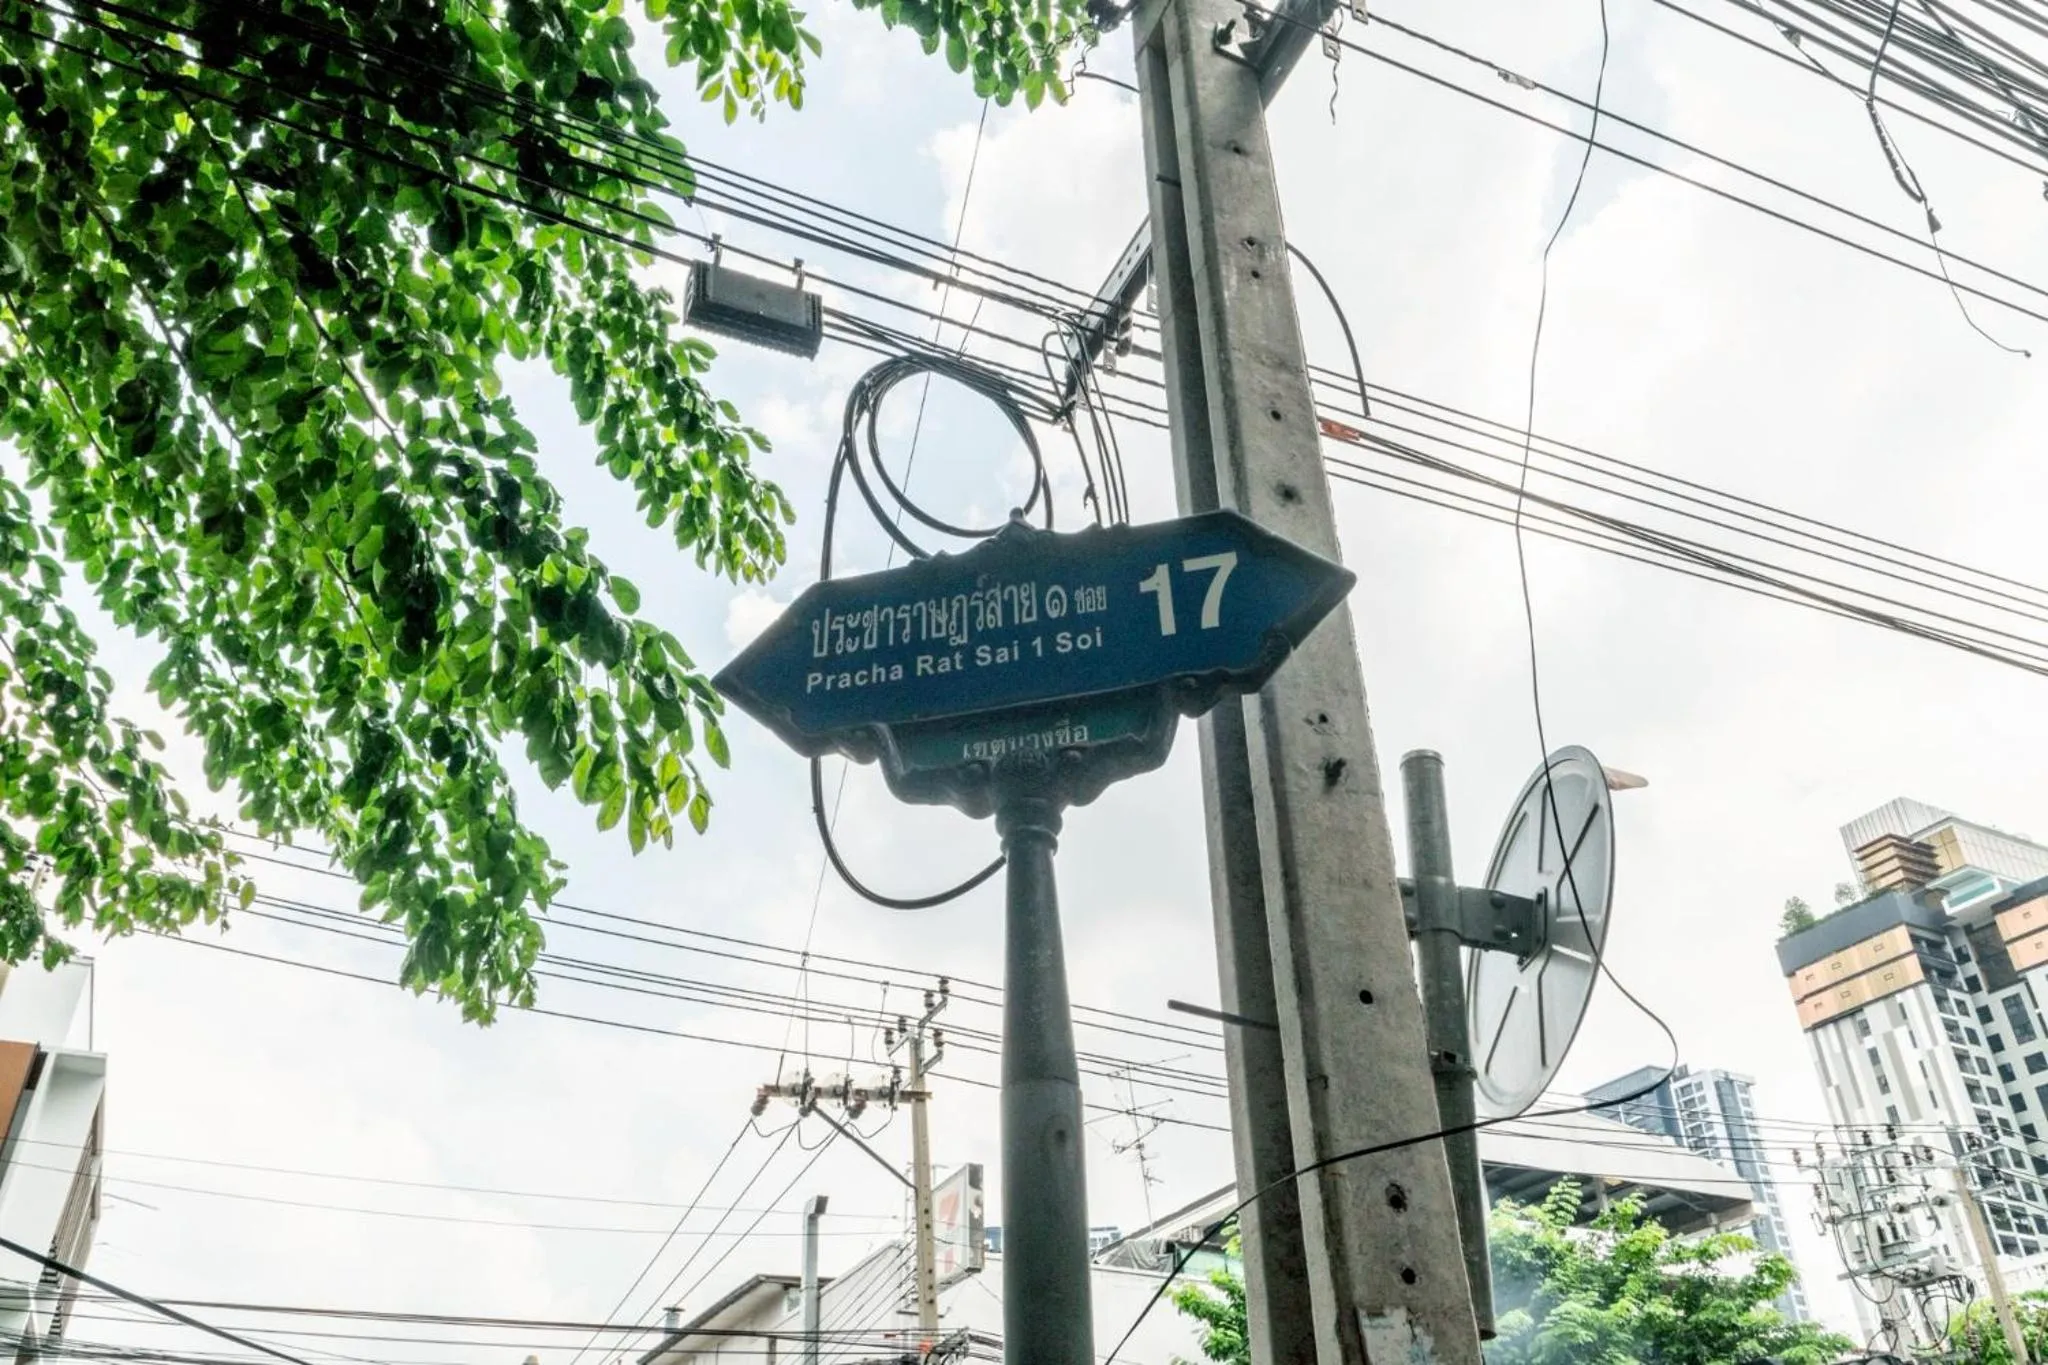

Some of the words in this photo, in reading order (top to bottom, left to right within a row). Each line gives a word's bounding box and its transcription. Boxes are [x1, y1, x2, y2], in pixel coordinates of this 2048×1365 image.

[1139, 551, 1238, 636] 17
[806, 663, 903, 694] Pracha
[916, 651, 963, 676] Rat
[975, 640, 1019, 666] Sai
[1031, 636, 1042, 657] 1
[1055, 626, 1103, 653] Soi
